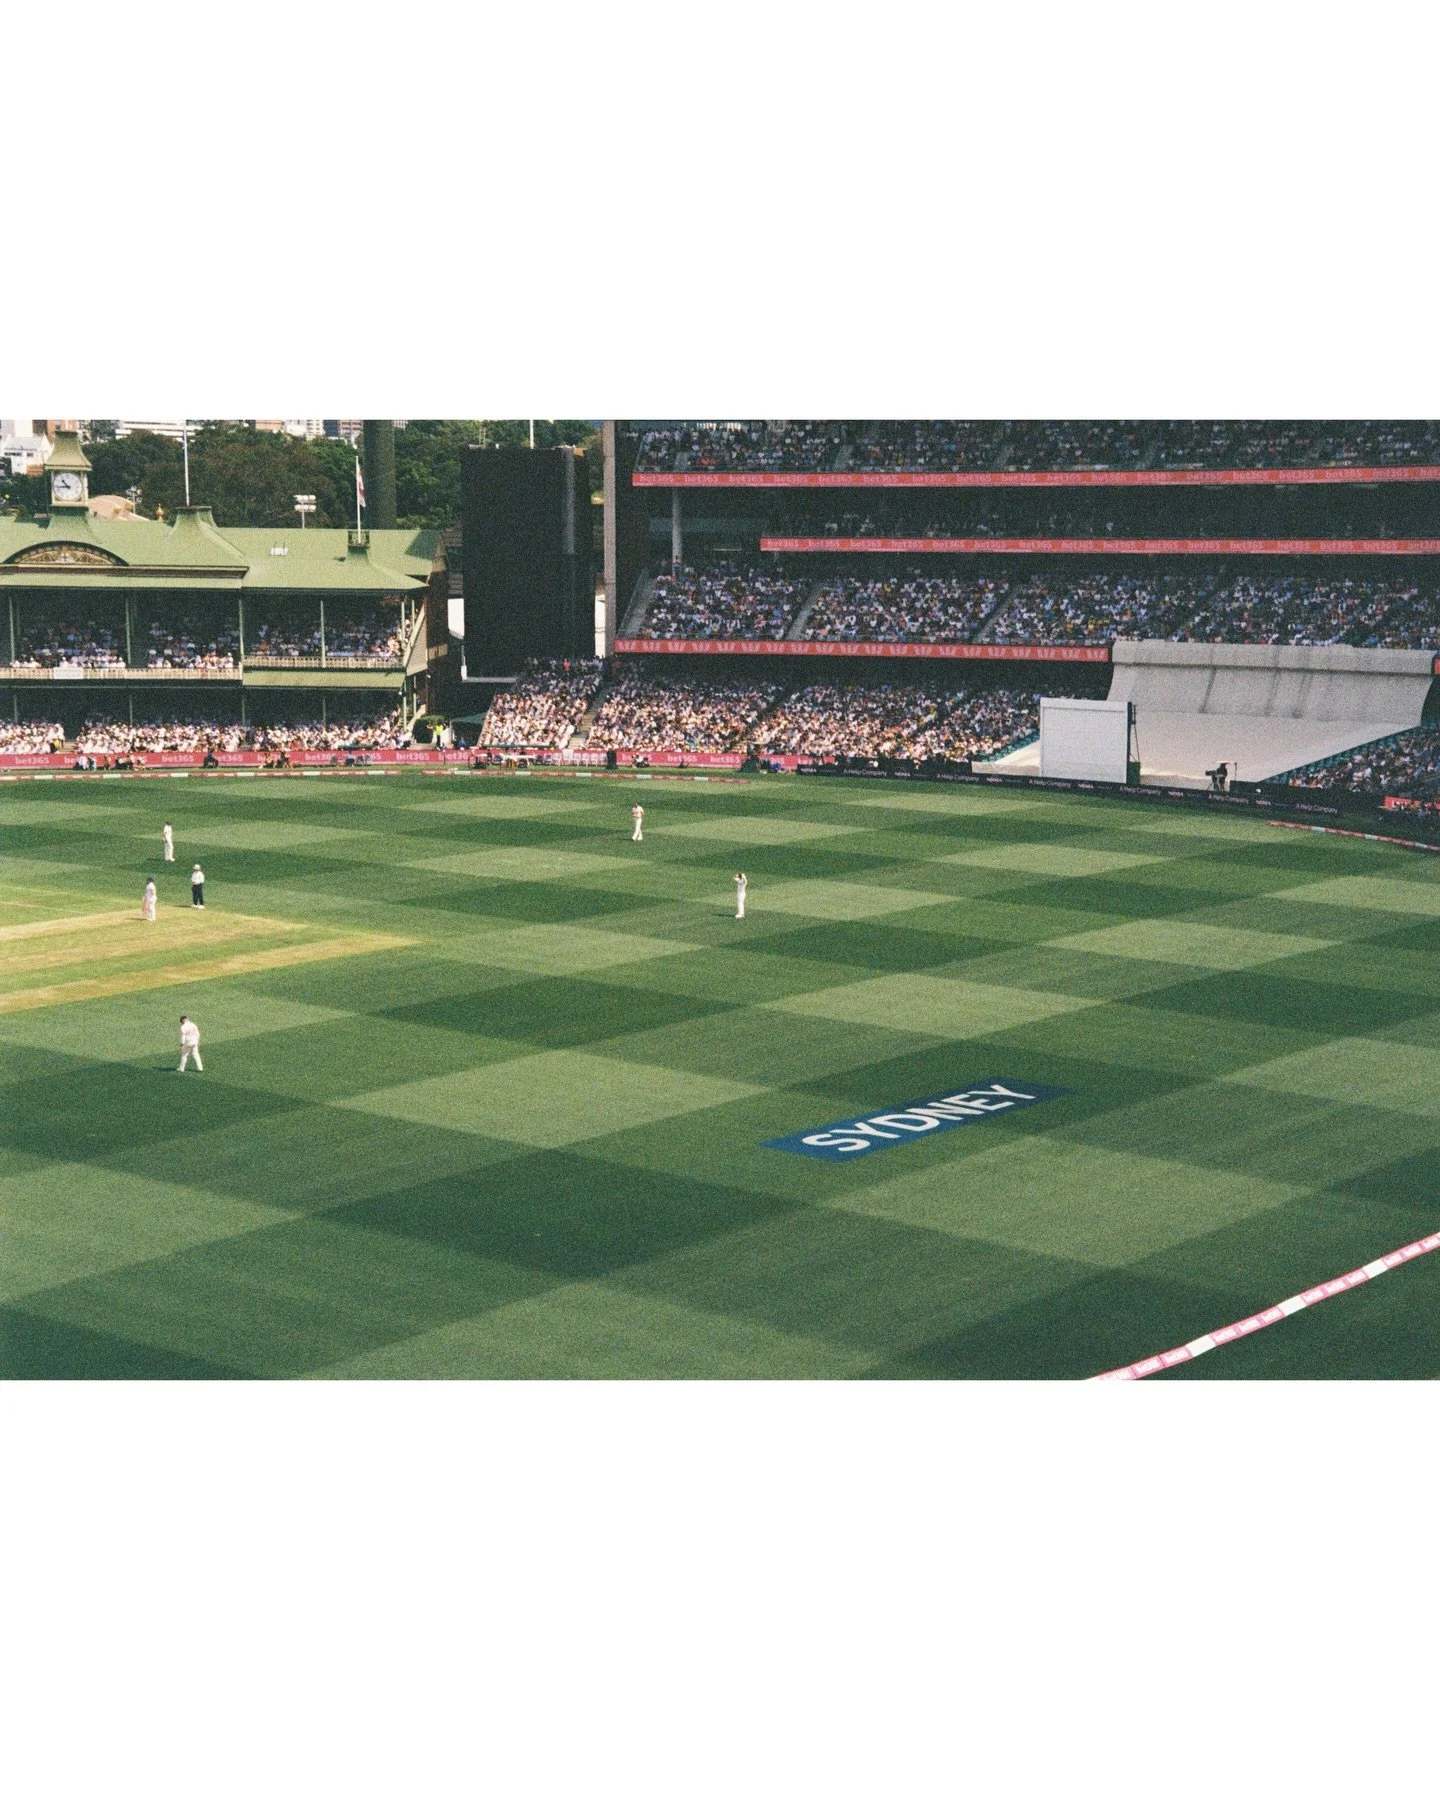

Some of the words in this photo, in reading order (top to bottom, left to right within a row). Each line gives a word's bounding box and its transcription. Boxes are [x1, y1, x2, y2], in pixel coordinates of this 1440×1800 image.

[16, 756, 50, 765] bet365
[162, 755, 195, 763] bet365
[217, 754, 244, 762] et365
[802, 1084, 1036, 1152] SYDNEY
